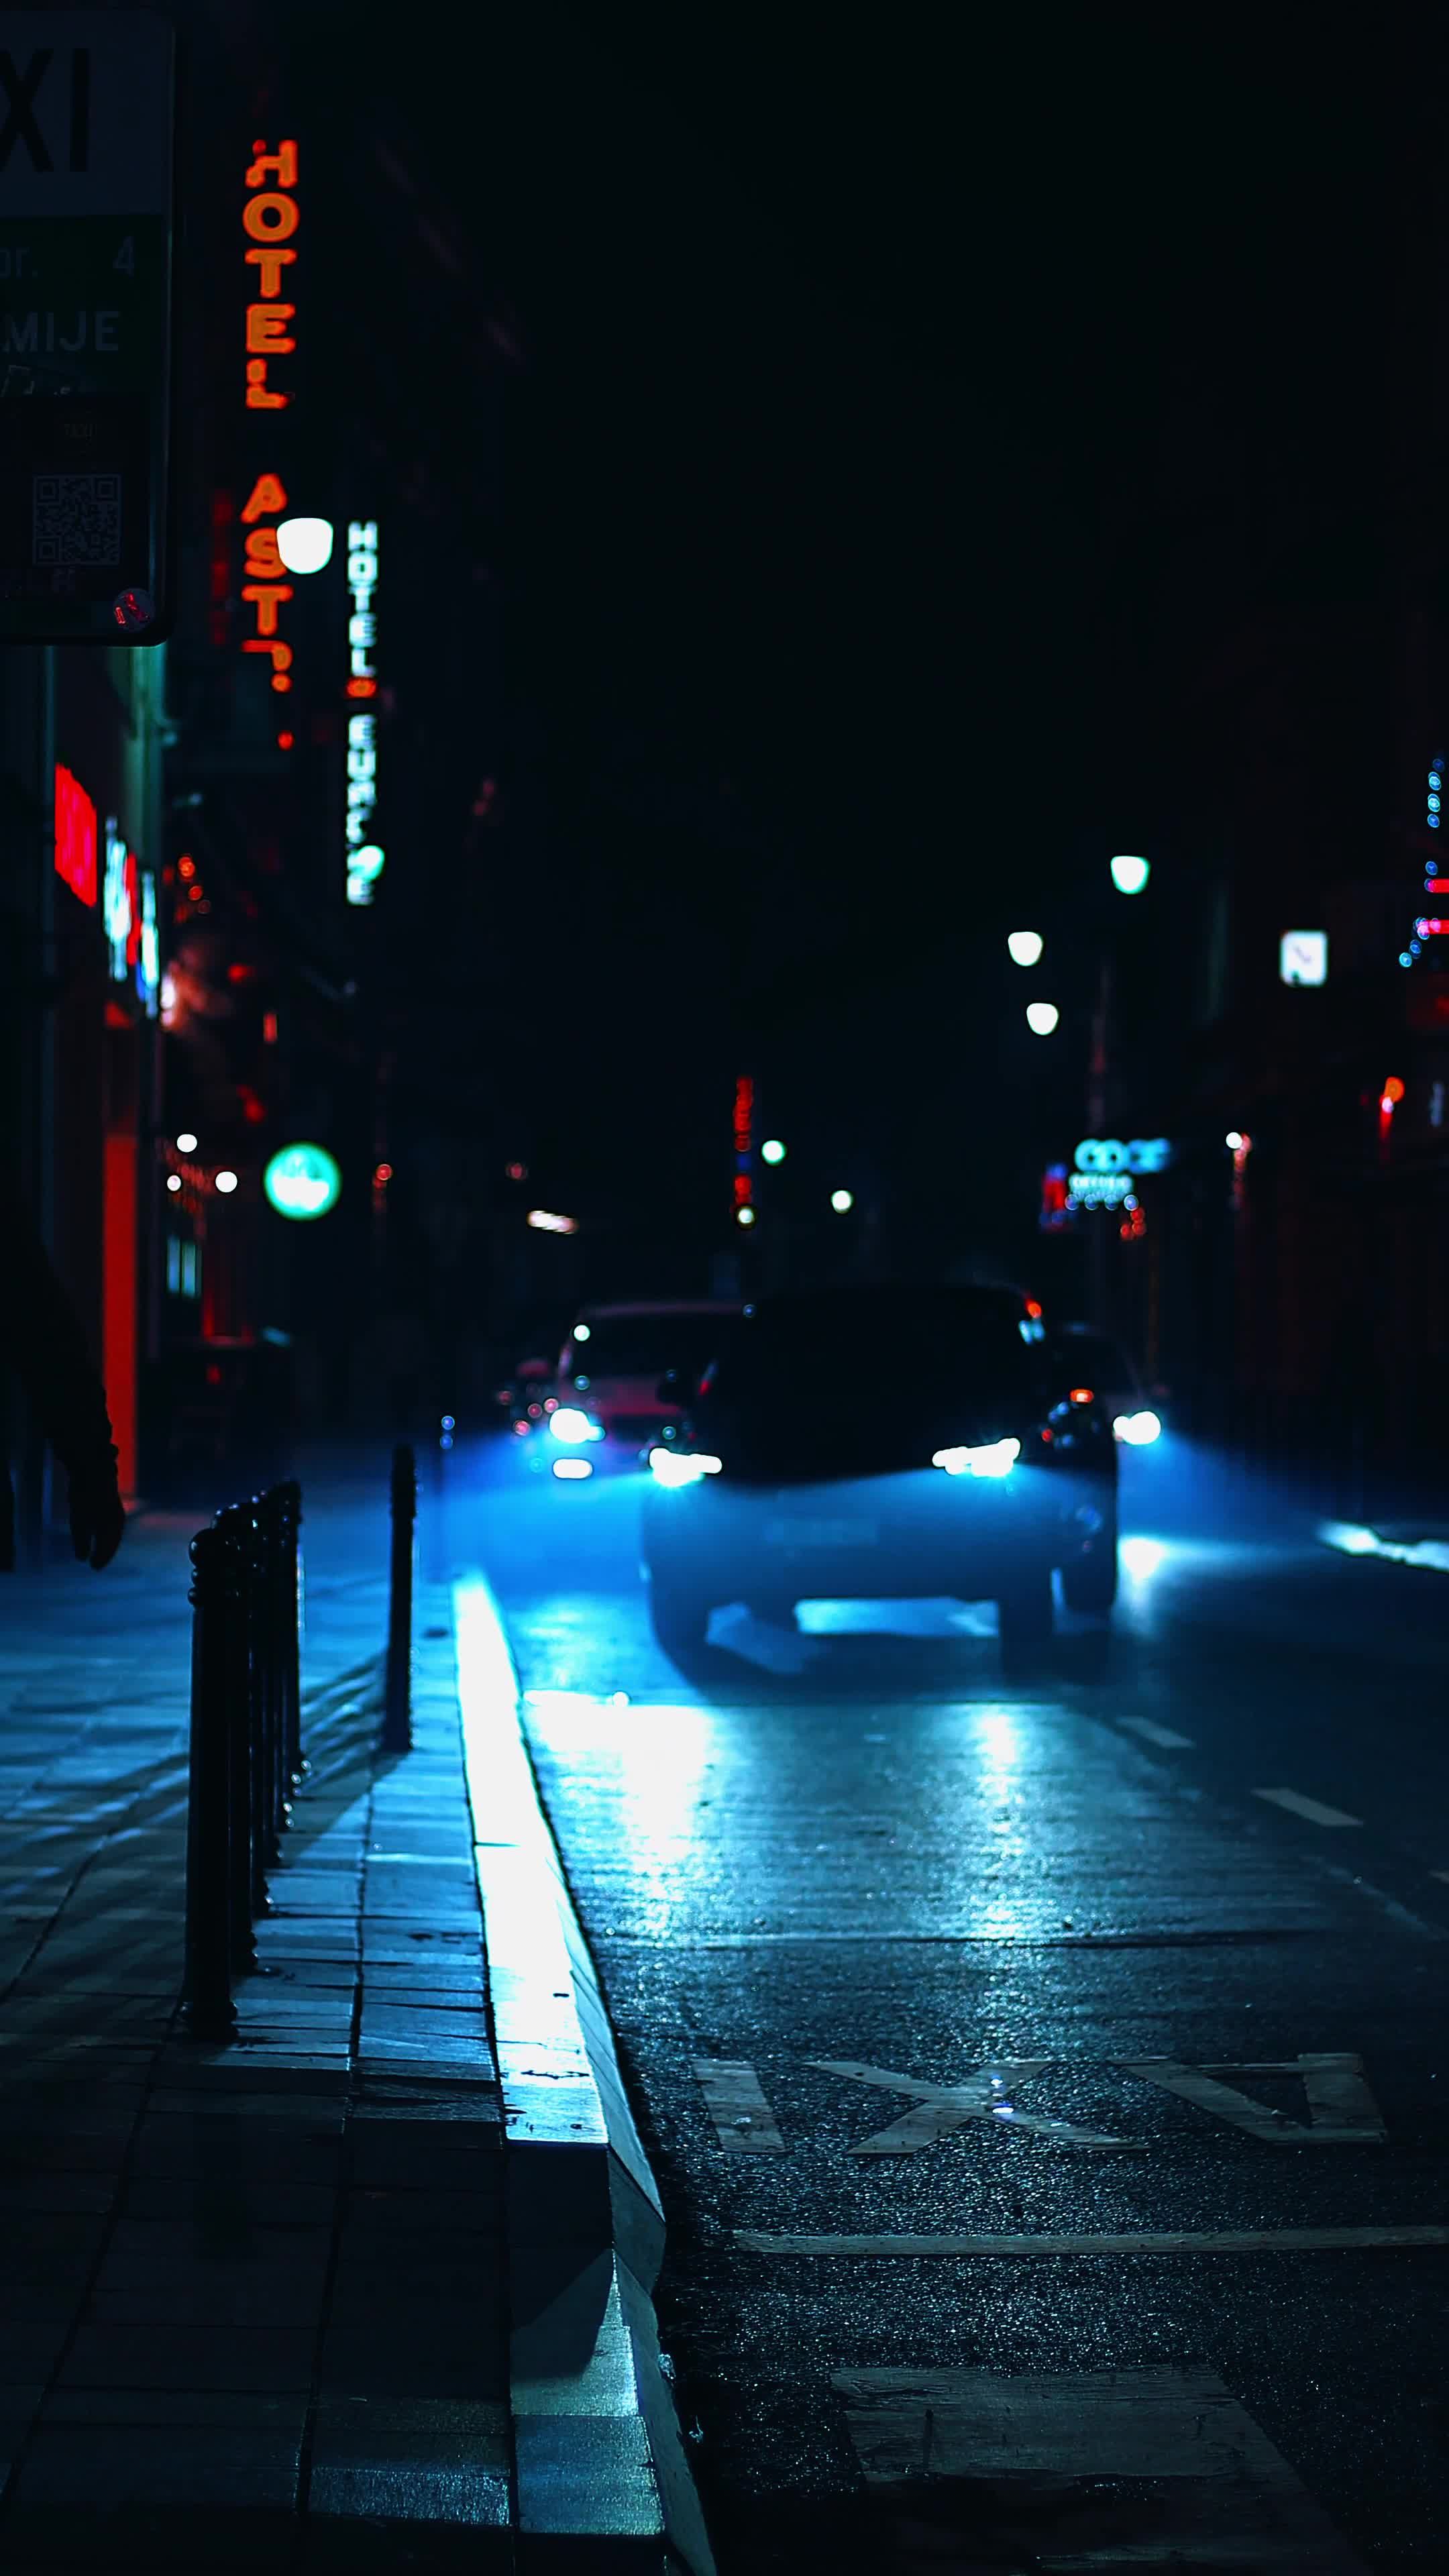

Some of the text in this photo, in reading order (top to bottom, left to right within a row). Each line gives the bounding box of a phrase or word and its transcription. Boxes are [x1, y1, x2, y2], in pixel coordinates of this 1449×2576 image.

[113, 235, 135, 278] 4
[243, 139, 299, 409] HOTEL
[347, 521, 377, 677] HOTEL
